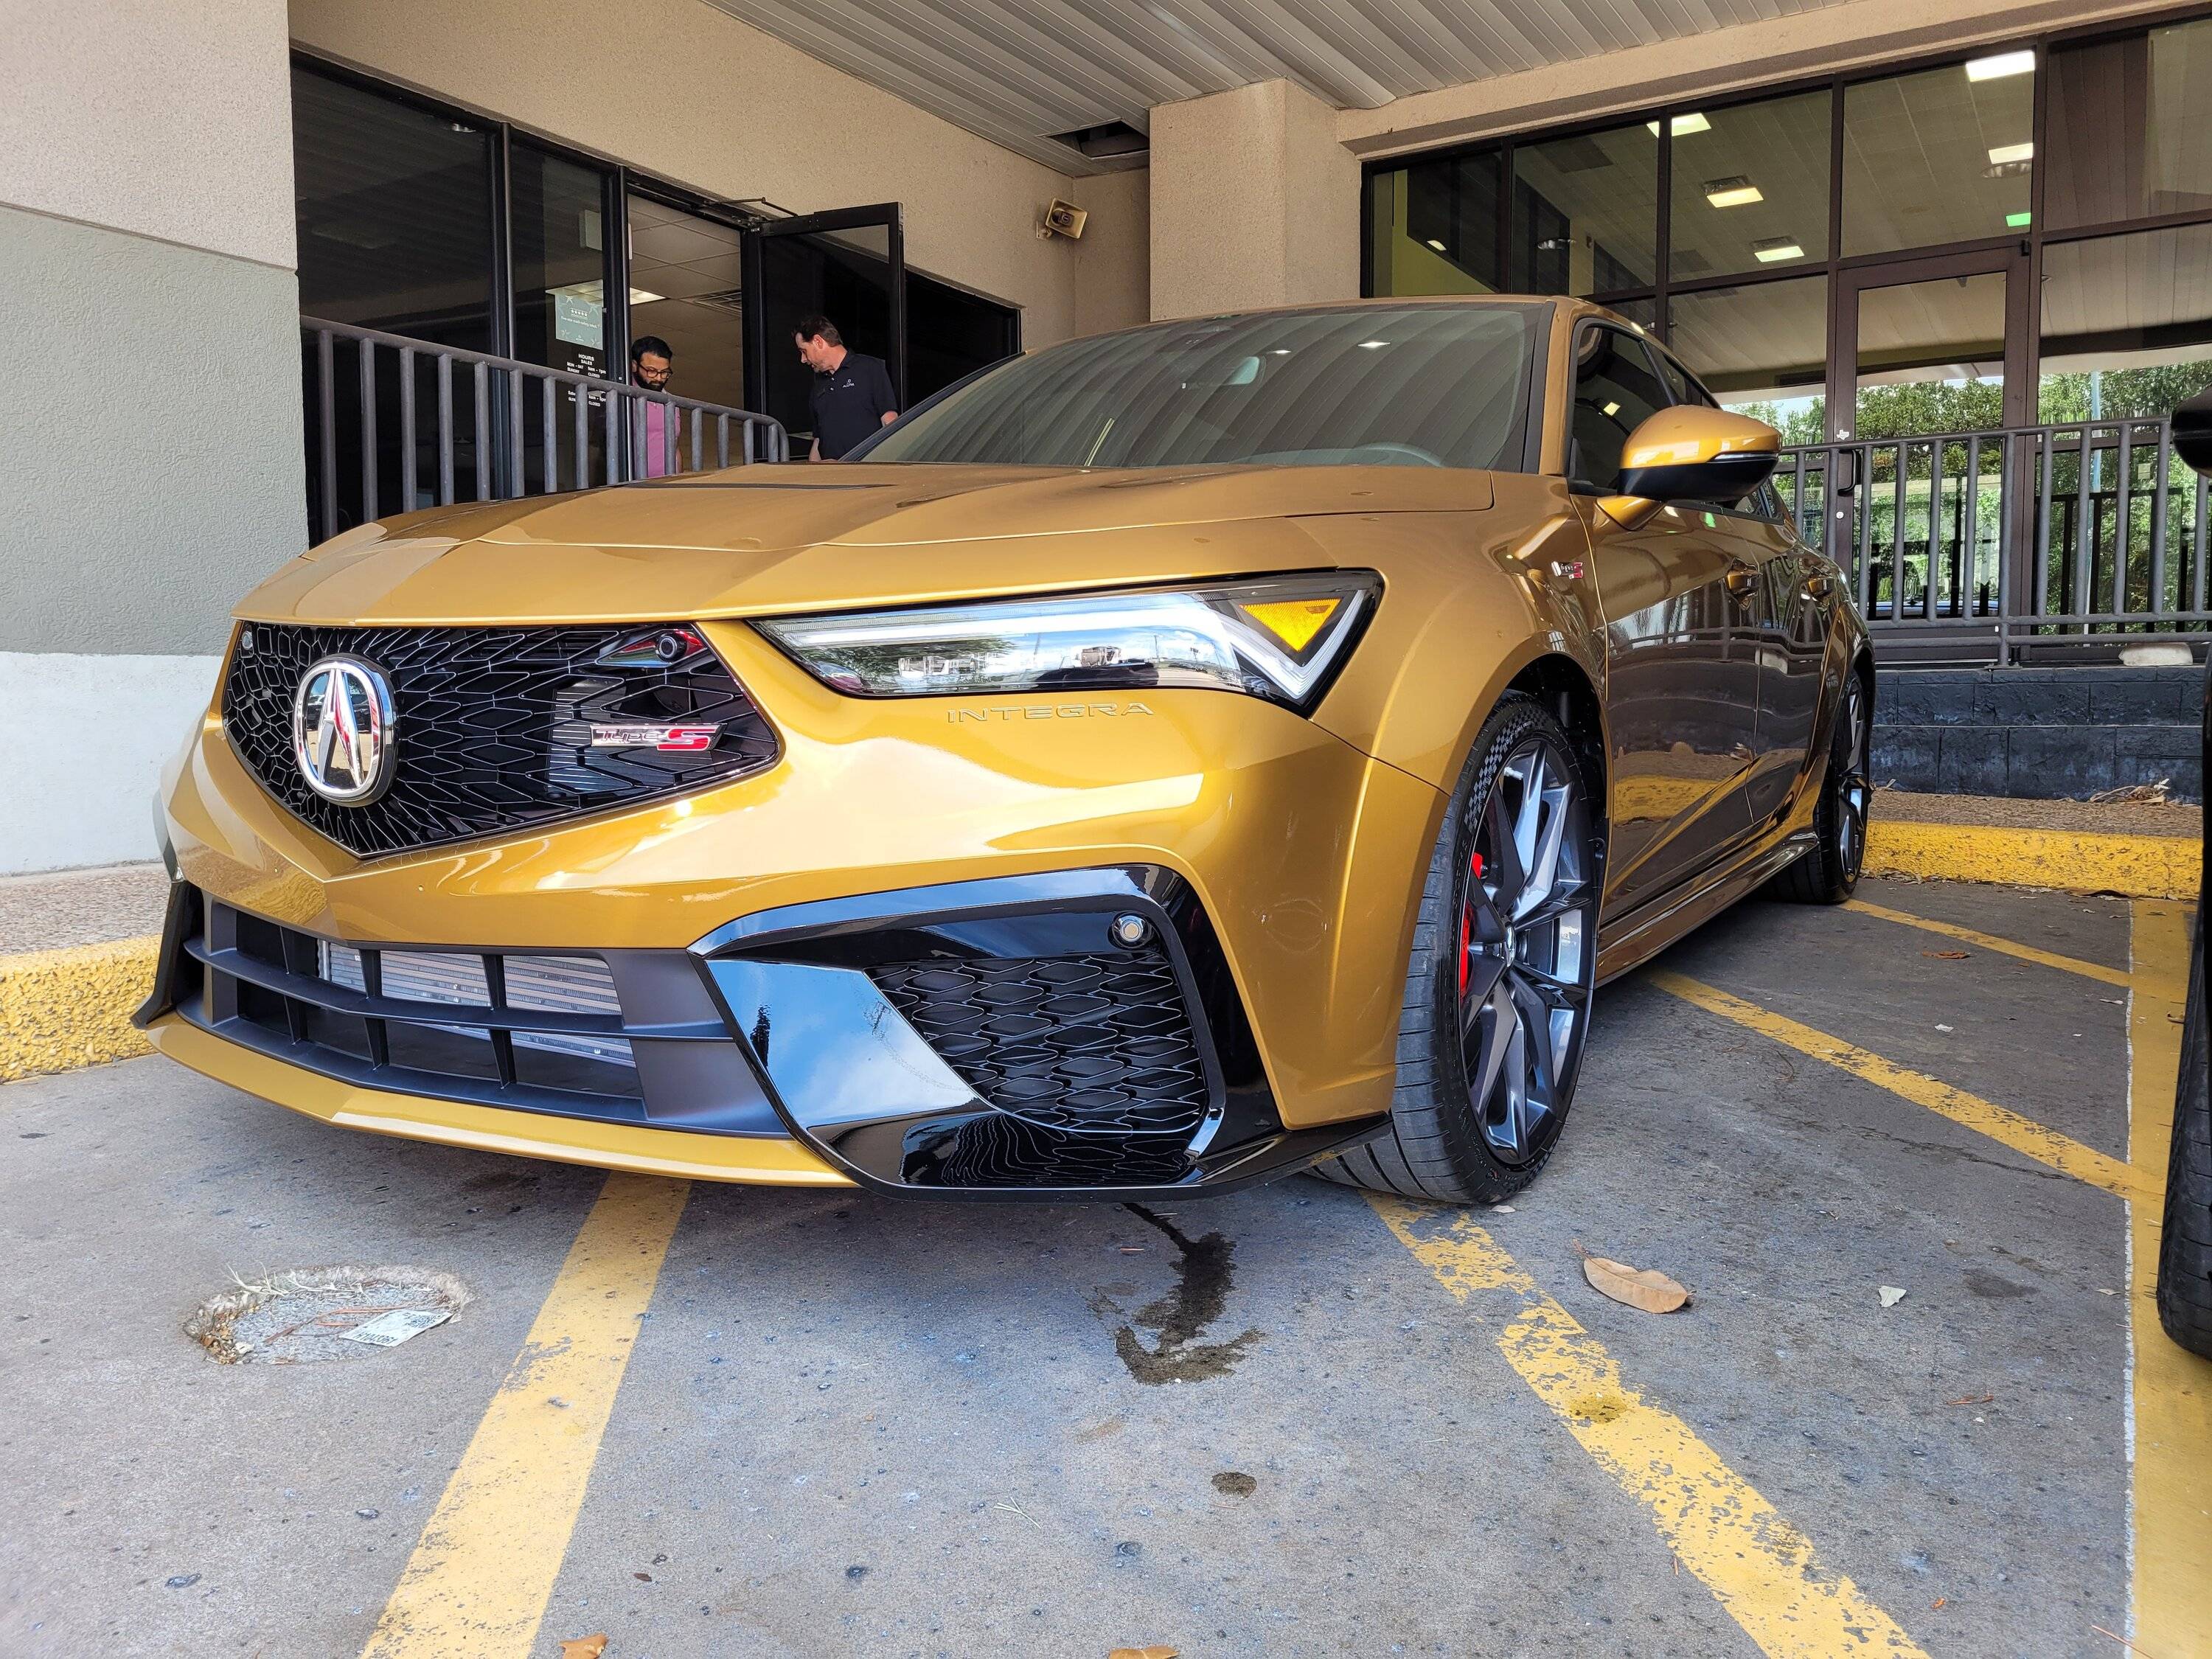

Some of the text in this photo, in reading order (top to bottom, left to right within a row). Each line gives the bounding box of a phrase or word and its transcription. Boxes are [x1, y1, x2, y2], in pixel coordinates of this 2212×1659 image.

[578, 353, 594, 361] HOURS
[947, 703, 1155, 723] INTEGRA
[656, 728, 718, 751] S
